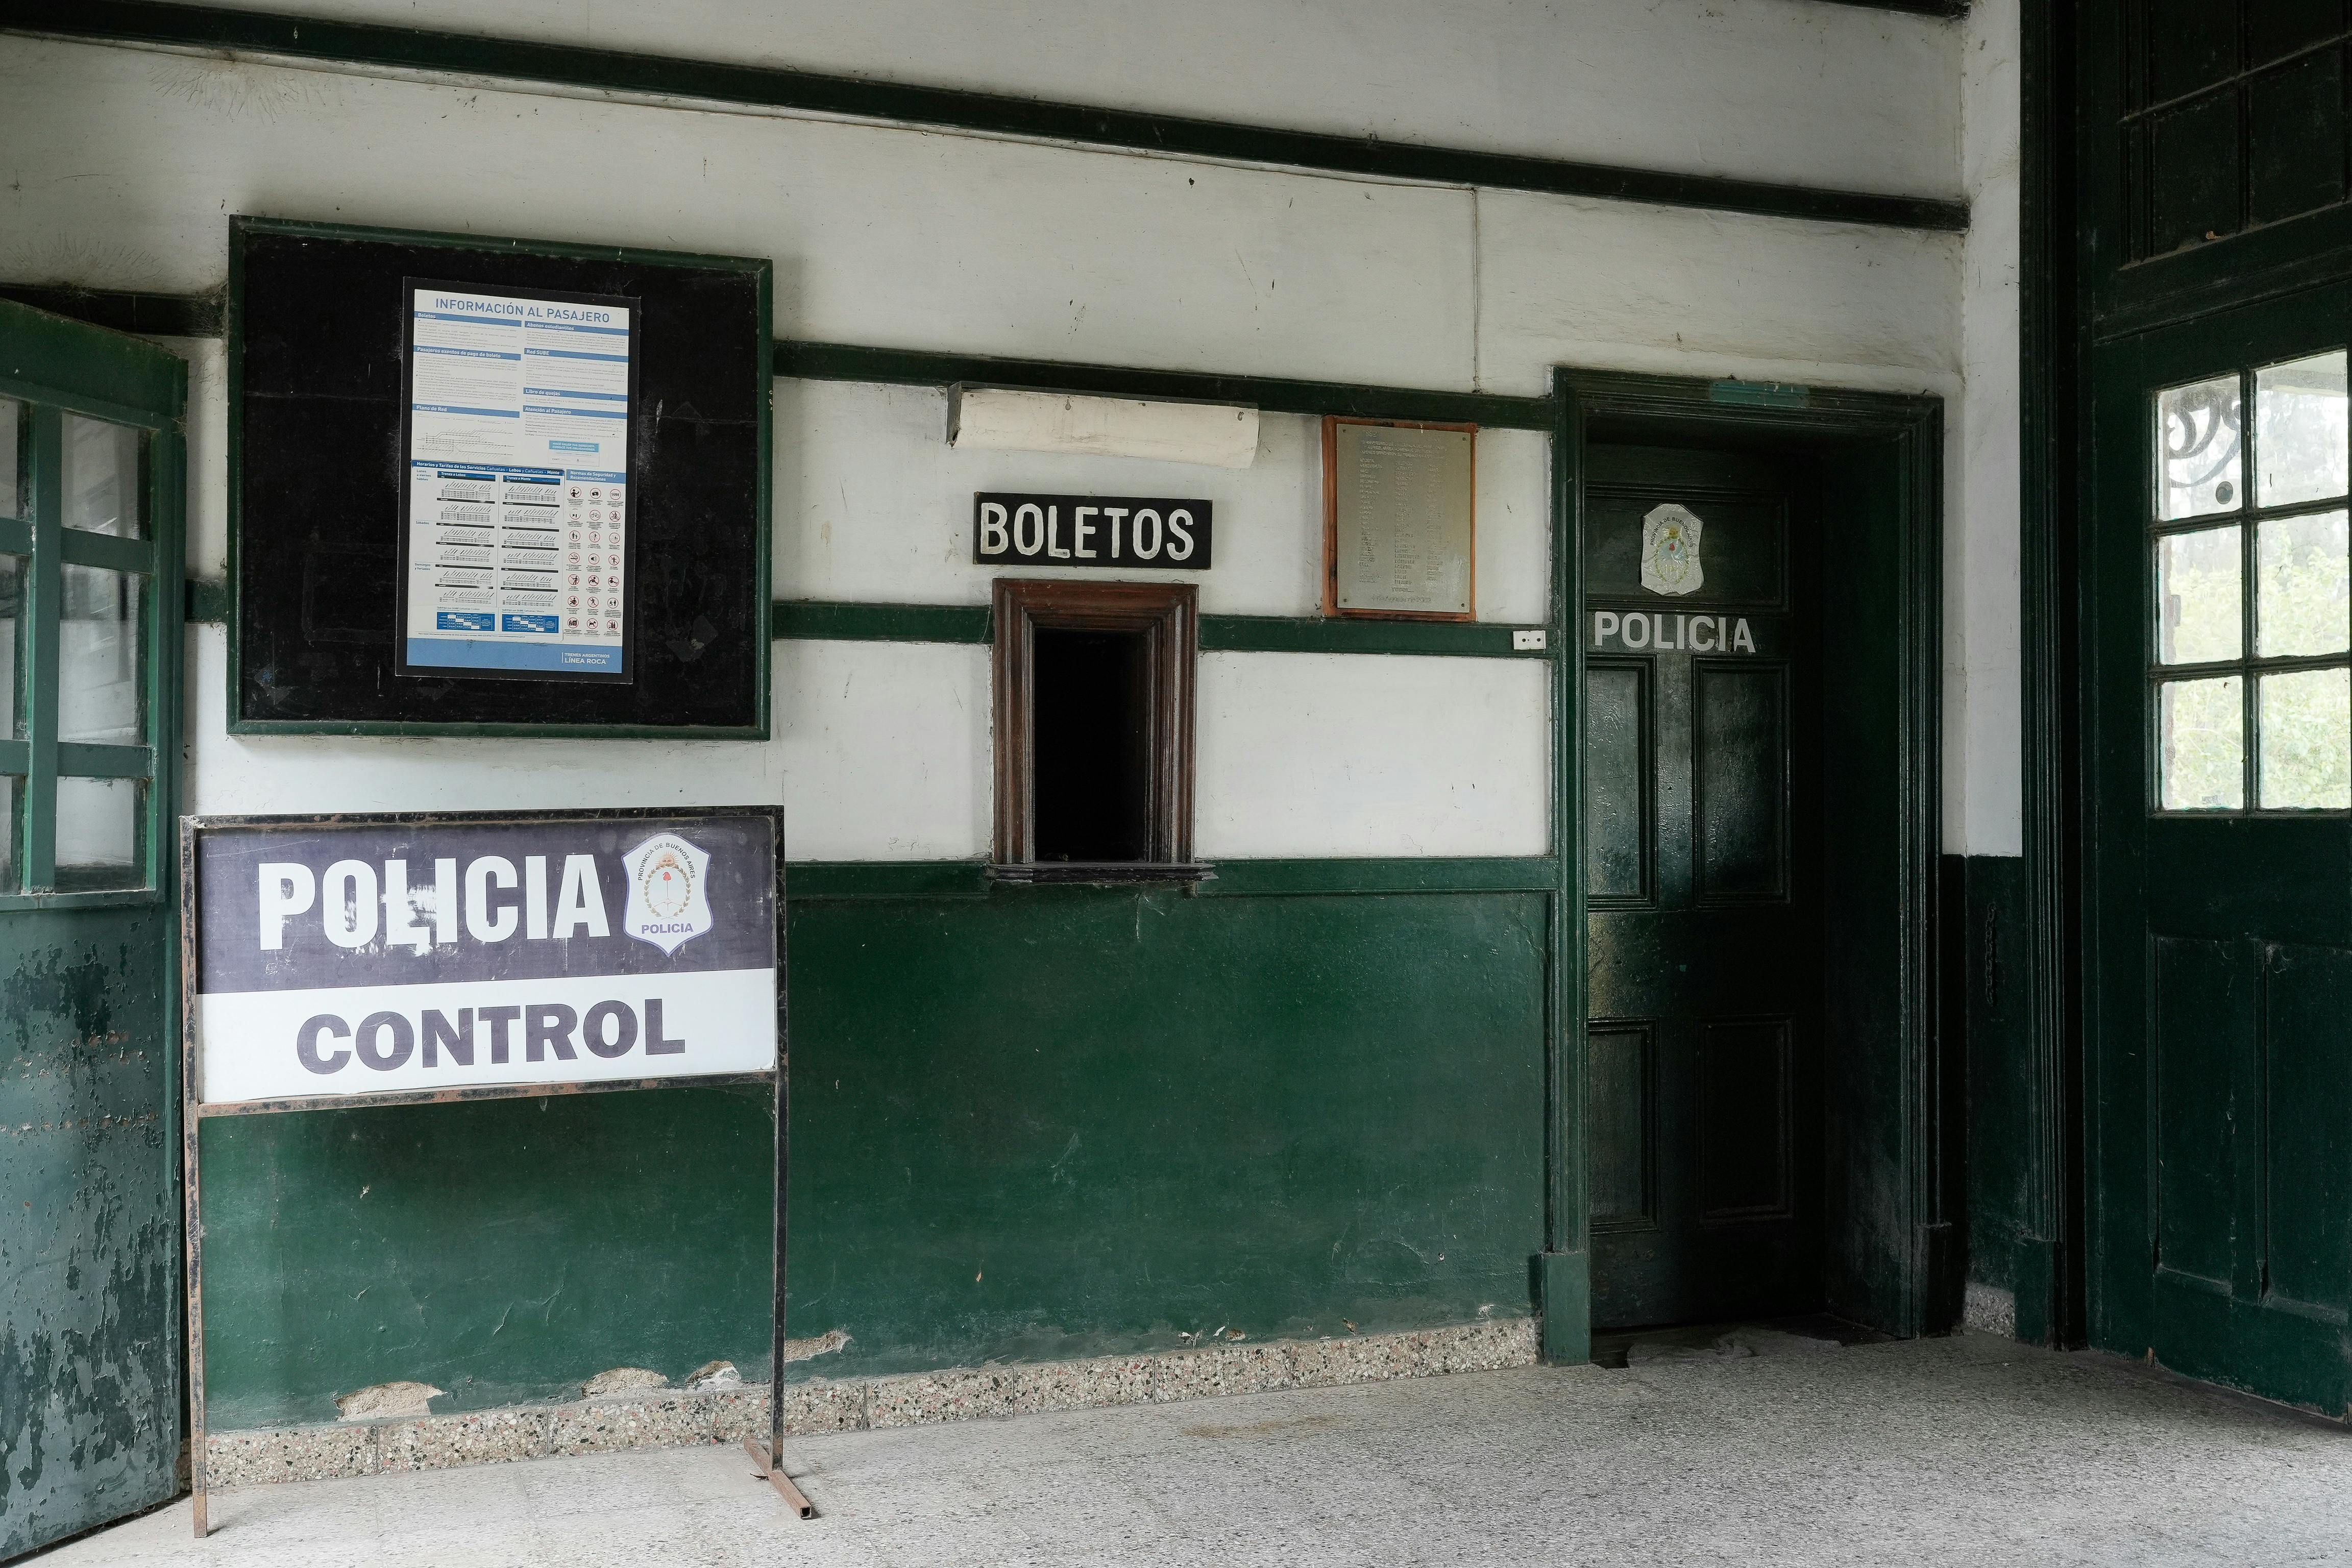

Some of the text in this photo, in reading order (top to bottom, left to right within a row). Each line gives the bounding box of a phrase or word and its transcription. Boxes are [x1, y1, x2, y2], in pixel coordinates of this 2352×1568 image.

[436, 298, 609, 323] INFORMACIÓN AL PASAJERO
[980, 502, 1194, 560] BOLETOS
[1650, 521, 1664, 546] PROVINCIA
[1595, 611, 1756, 653] POLICIA
[638, 842, 696, 880] PROVINCIA DE BUENOS AIRES
[258, 854, 610, 951] POLICIA
[641, 923, 694, 934] POLICIA
[297, 998, 685, 1075] CONTROL
